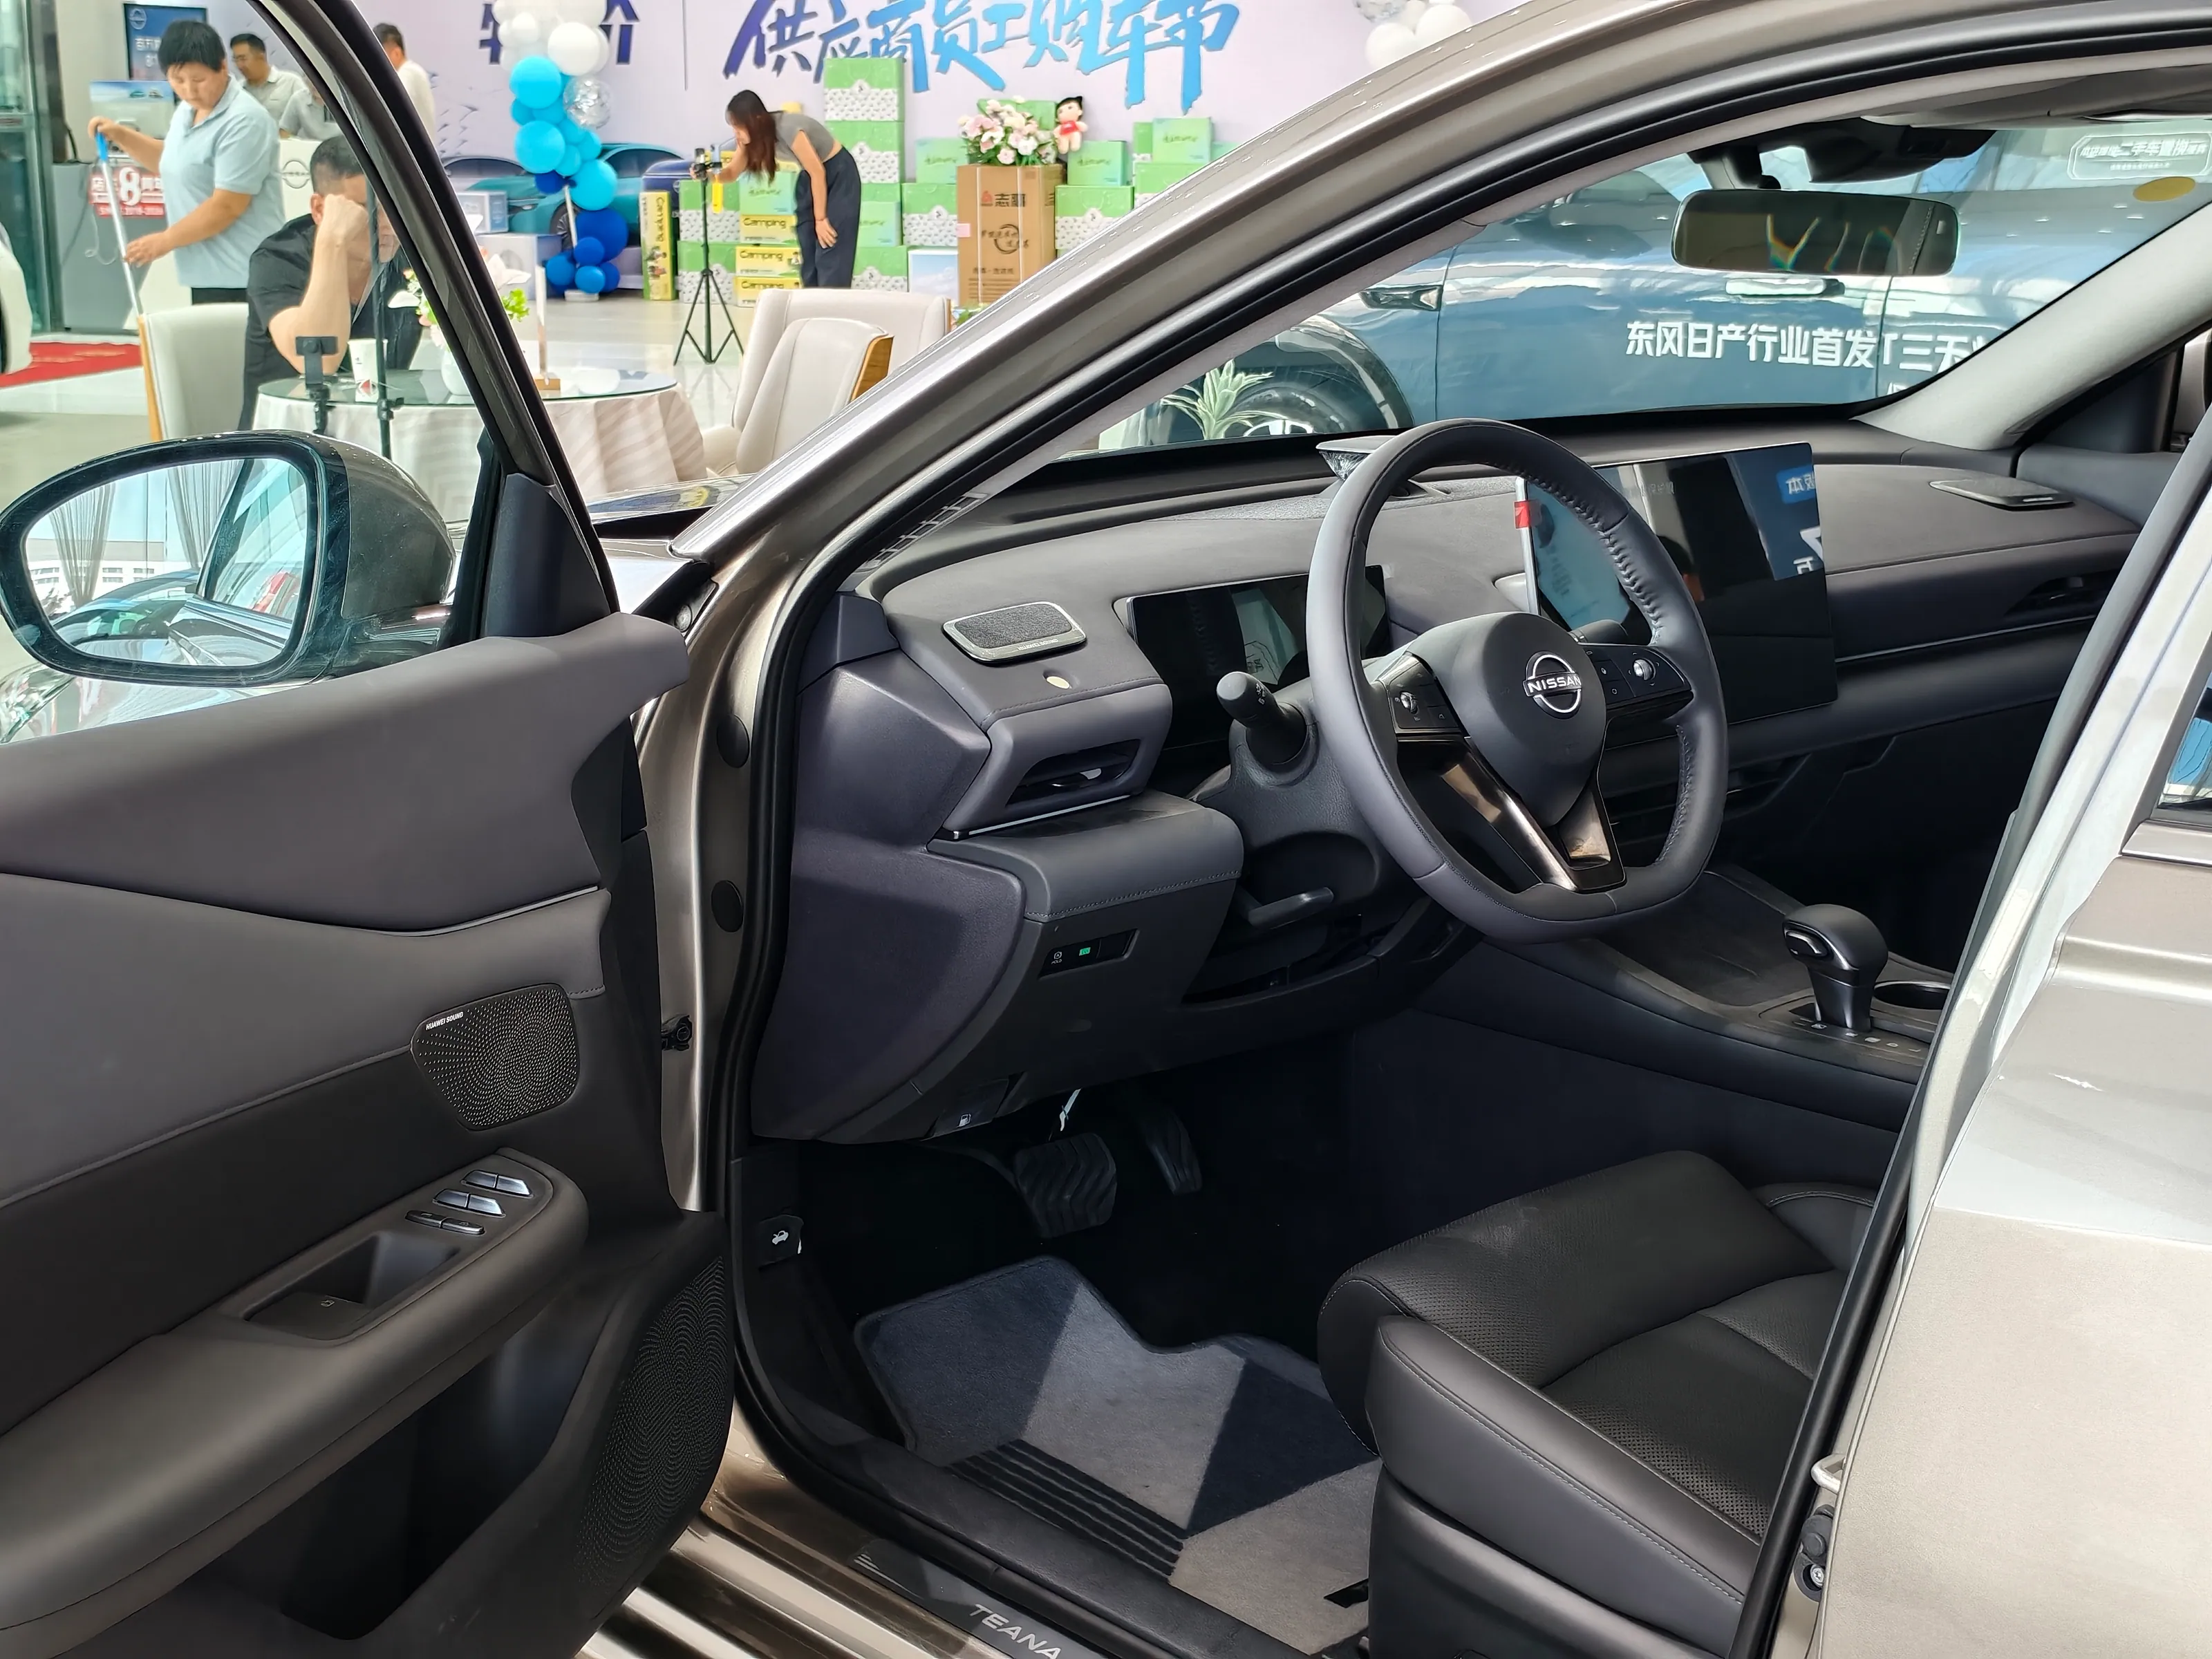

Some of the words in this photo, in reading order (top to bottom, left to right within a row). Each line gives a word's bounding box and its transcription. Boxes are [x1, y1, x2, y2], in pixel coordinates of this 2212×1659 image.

[722, 0, 1240, 115] 供应商员工购车节
[743, 218, 787, 229] Camping
[740, 250, 783, 261] Camping
[1527, 675, 1582, 693] NISSAN
[426, 1018, 447, 1031] HUAWEI
[446, 1011, 464, 1023] SOUND
[969, 1603, 1062, 1659] TEANA
